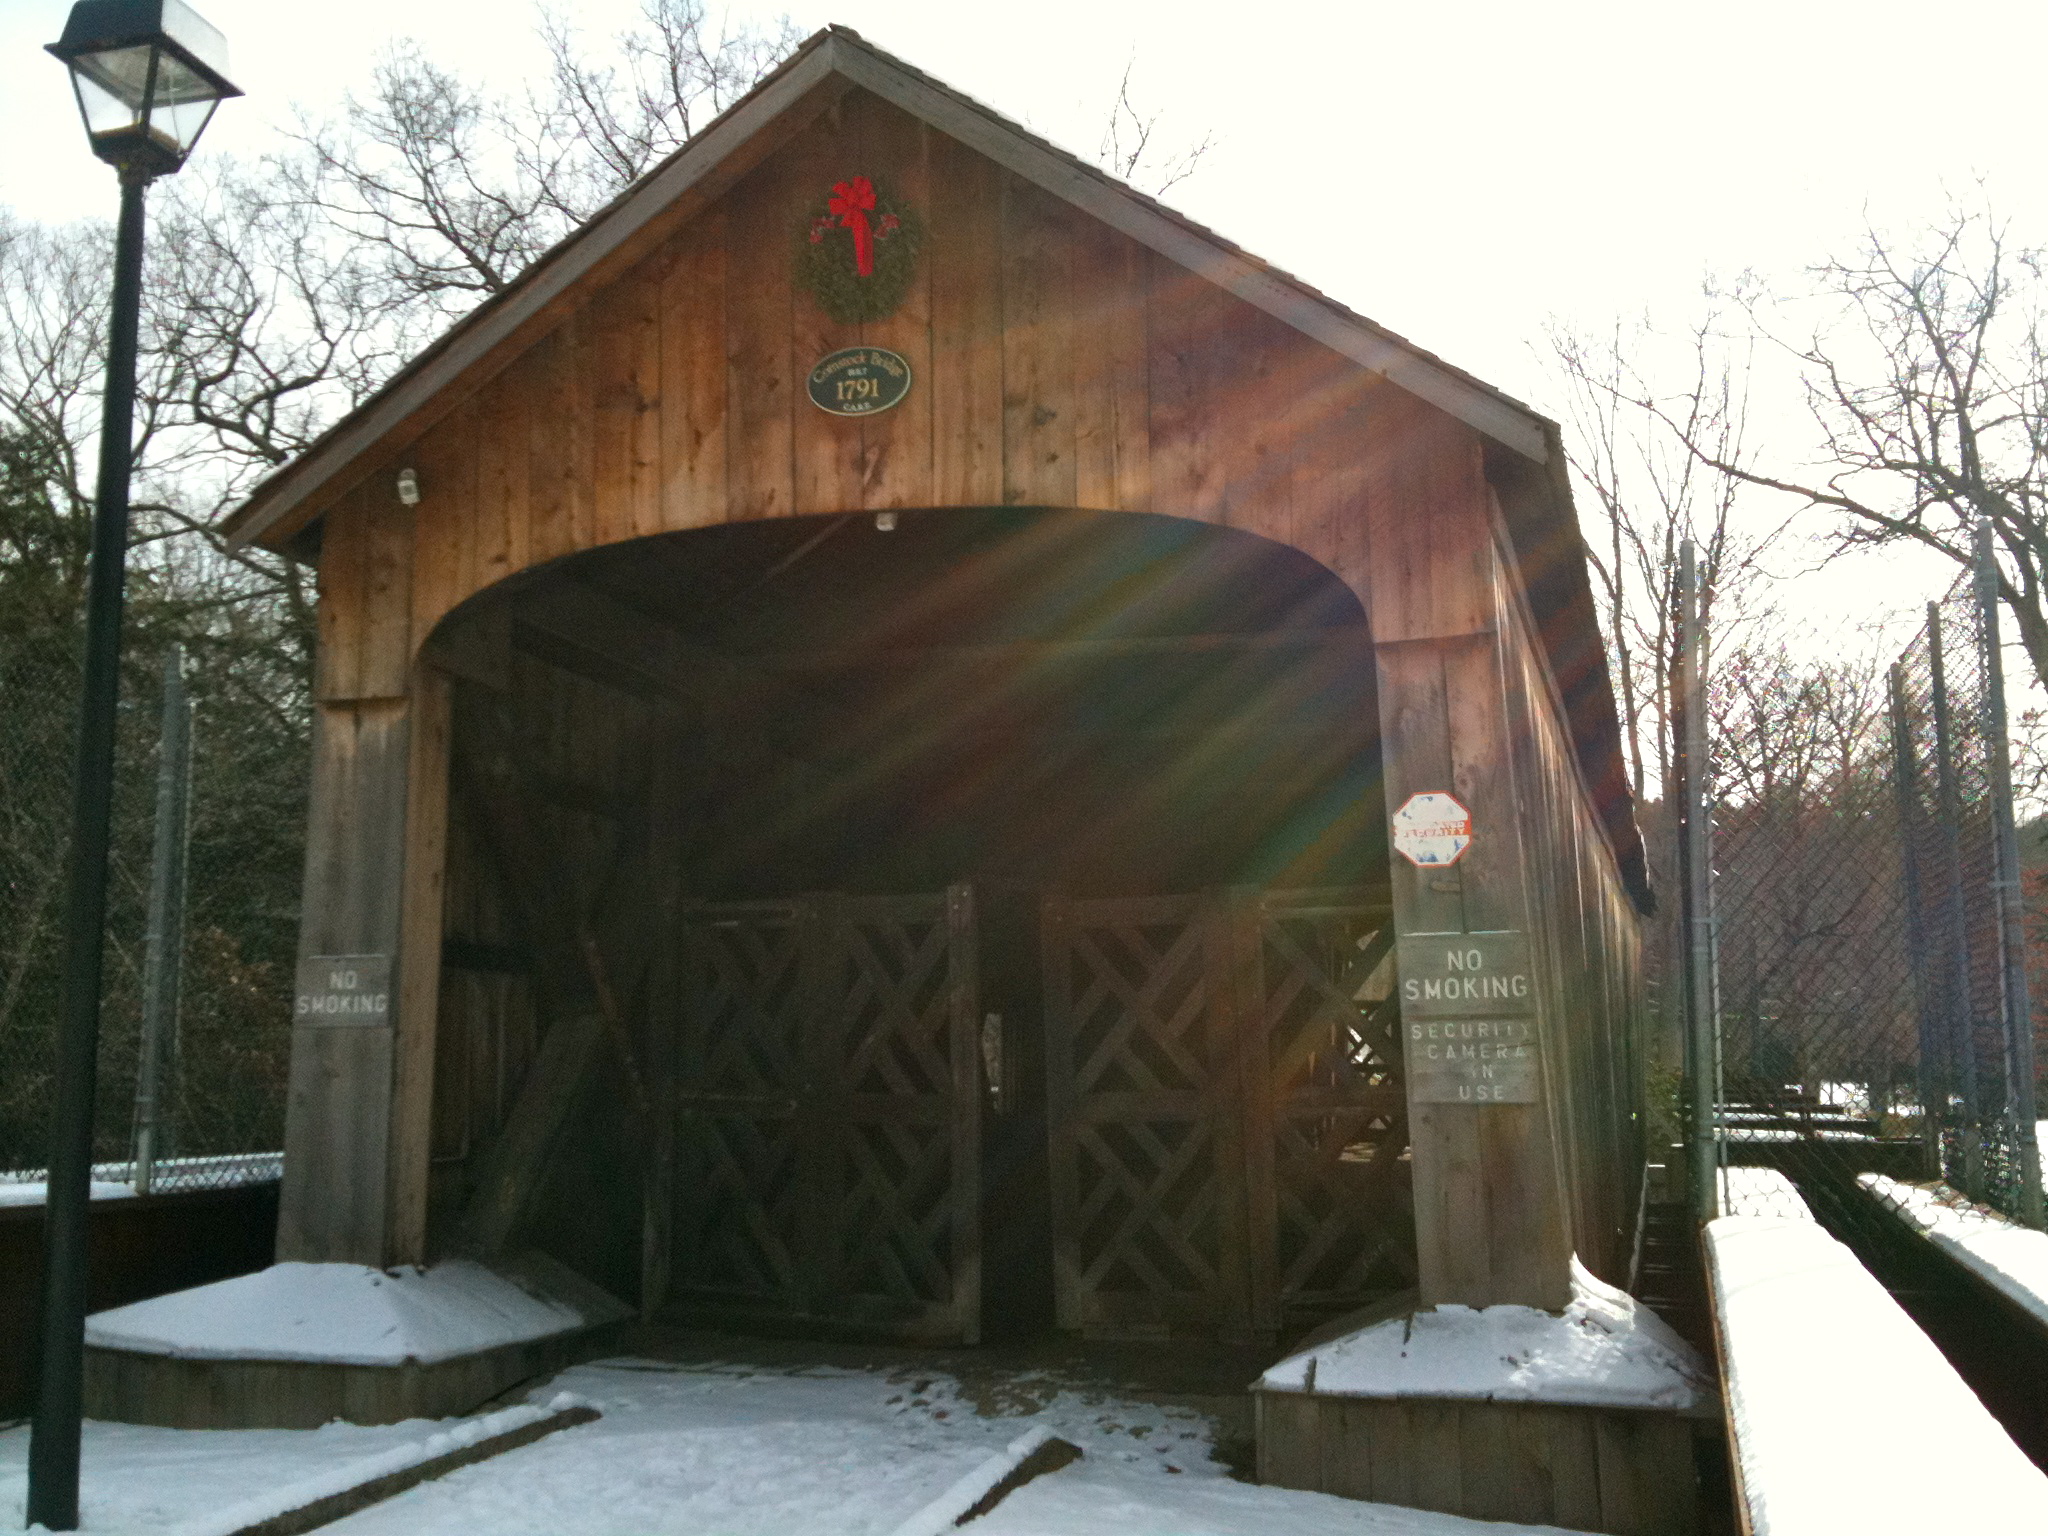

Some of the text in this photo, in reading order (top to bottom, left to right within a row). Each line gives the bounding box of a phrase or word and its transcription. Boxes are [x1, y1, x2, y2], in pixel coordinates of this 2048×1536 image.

[837, 378, 879, 400] 1791
[1447, 949, 1482, 971] NO
[330, 970, 357, 989] NO
[1405, 974, 1528, 1000] SMOKING
[297, 994, 387, 1013] SMOKING
[1427, 1043, 1526, 1059] CAMERA
[1459, 1085, 1504, 1100] USE
